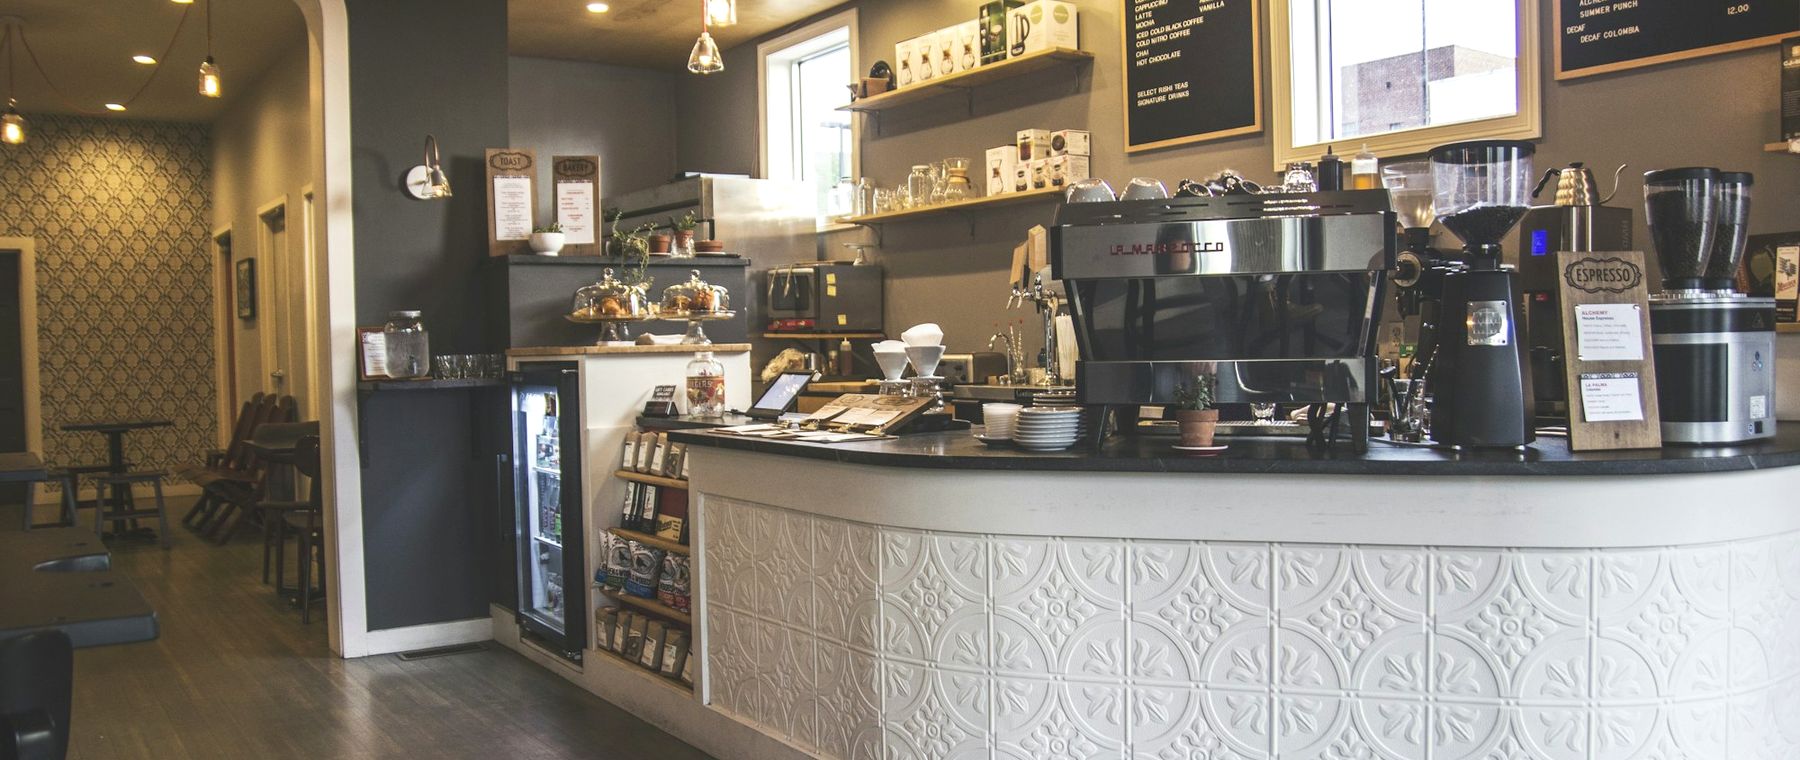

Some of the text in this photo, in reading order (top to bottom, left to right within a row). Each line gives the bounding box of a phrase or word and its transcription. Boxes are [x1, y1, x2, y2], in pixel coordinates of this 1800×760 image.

[1199, 1, 1225, 12] VANILLA
[1580, 1, 1638, 18] SUMMER PUNCH
[1727, 4, 1749, 15] 12.00
[1135, 11, 1153, 21] LATTE
[1135, 19, 1155, 29] MOCHA
[1136, 16, 1204, 39] ICED COLD BLACK COFFEE
[1566, 24, 1586, 35] DECAF
[1136, 28, 1191, 48] COLD NITRO COFFEE
[1580, 26, 1640, 43] DECAF COLOMBIA
[1136, 50, 1149, 58] CHAI
[1136, 50, 1181, 67] HOT CHOCOLATE
[1137, 81, 1189, 98] SELECT RISHI TEAS
[1137, 90, 1190, 107] SIGNATURE DRINKS
[500, 157, 521, 166] TOAST
[1576, 268, 1630, 282] ESPRESSO
